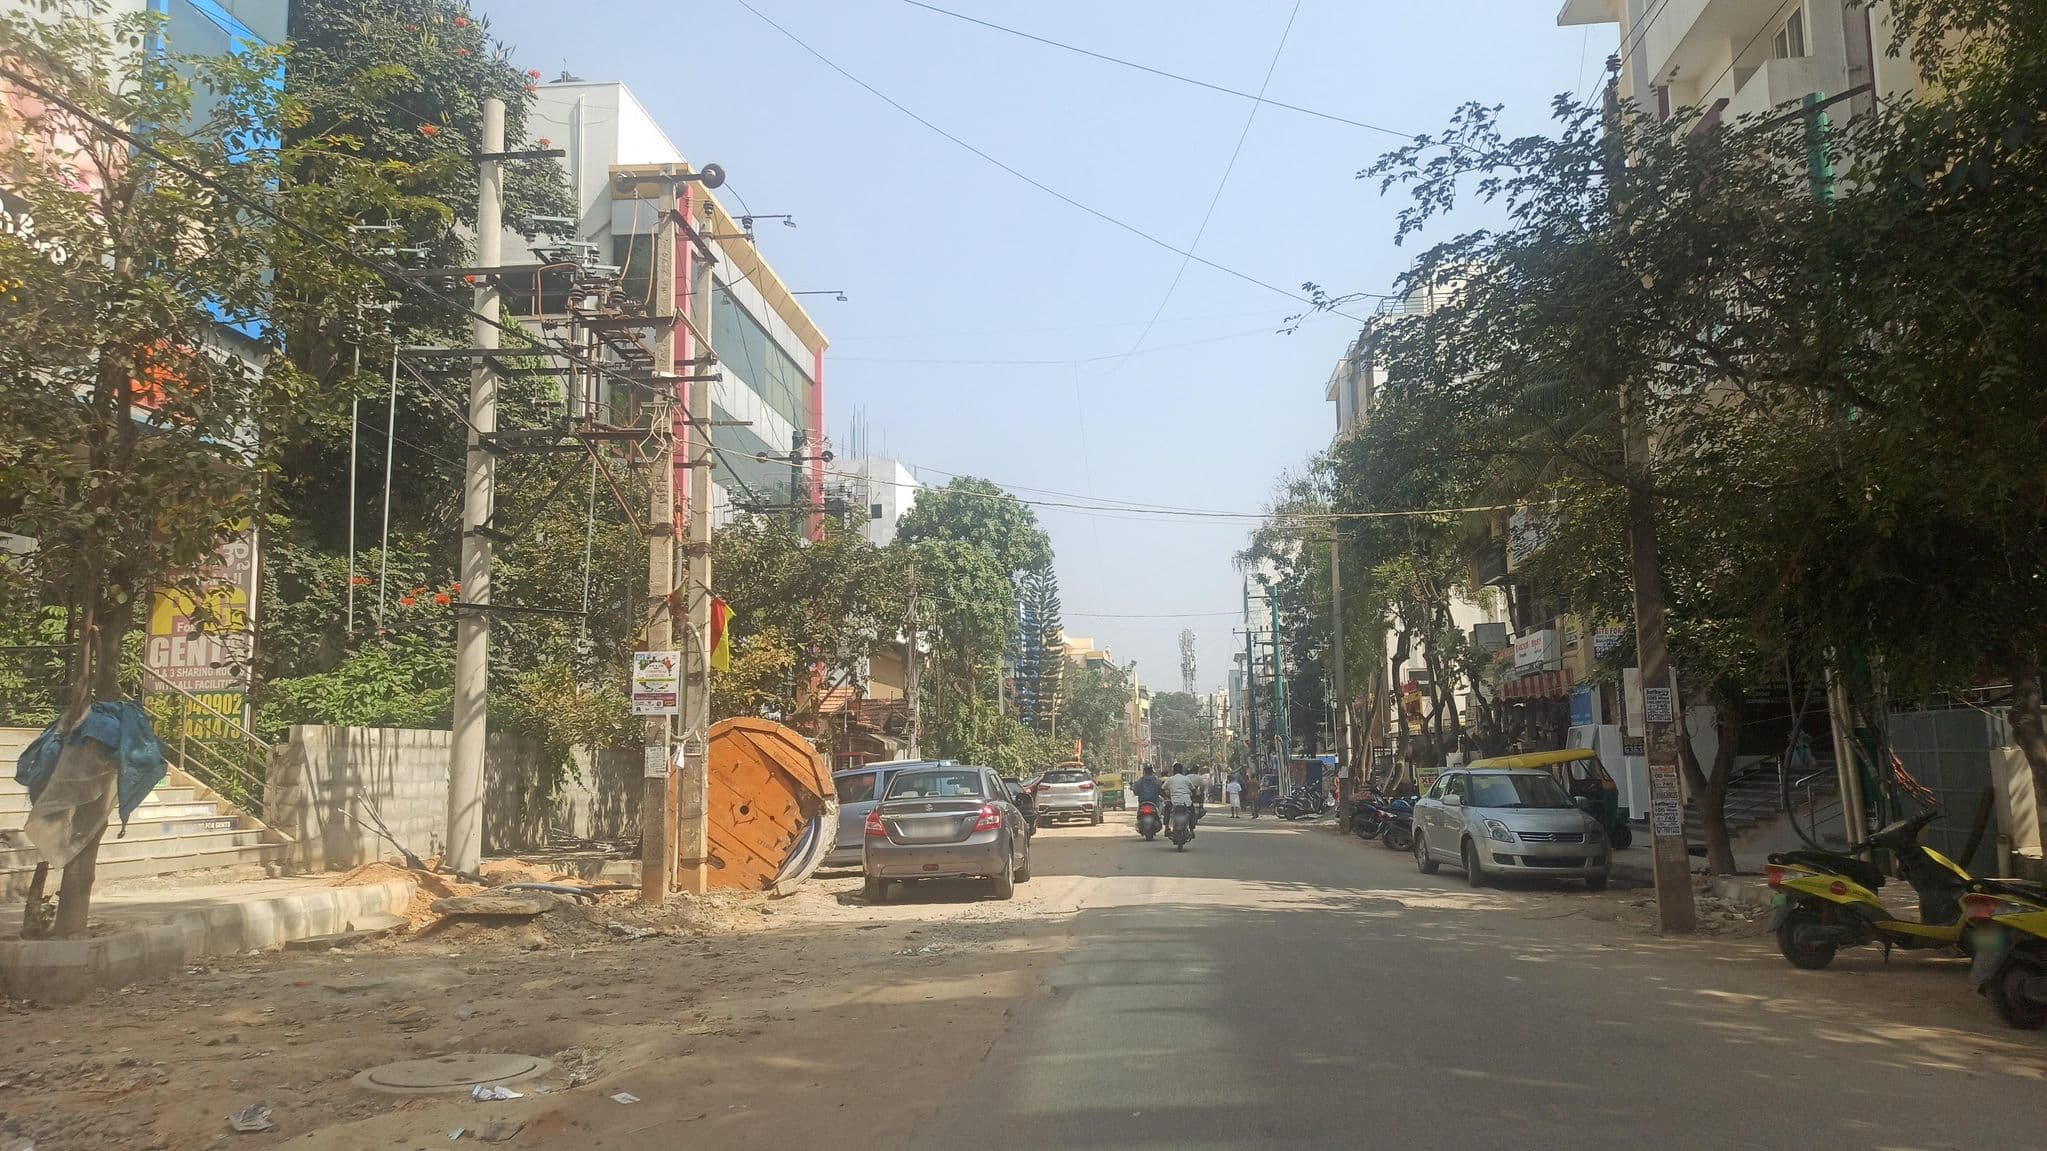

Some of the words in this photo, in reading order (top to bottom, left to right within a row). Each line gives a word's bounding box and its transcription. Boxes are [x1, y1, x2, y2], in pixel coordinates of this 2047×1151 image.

[151, 586, 247, 636] PG
[170, 668, 175, 678] 3
[177, 667, 213, 678] SHARING
[195, 679, 241, 691] FACILITIE
